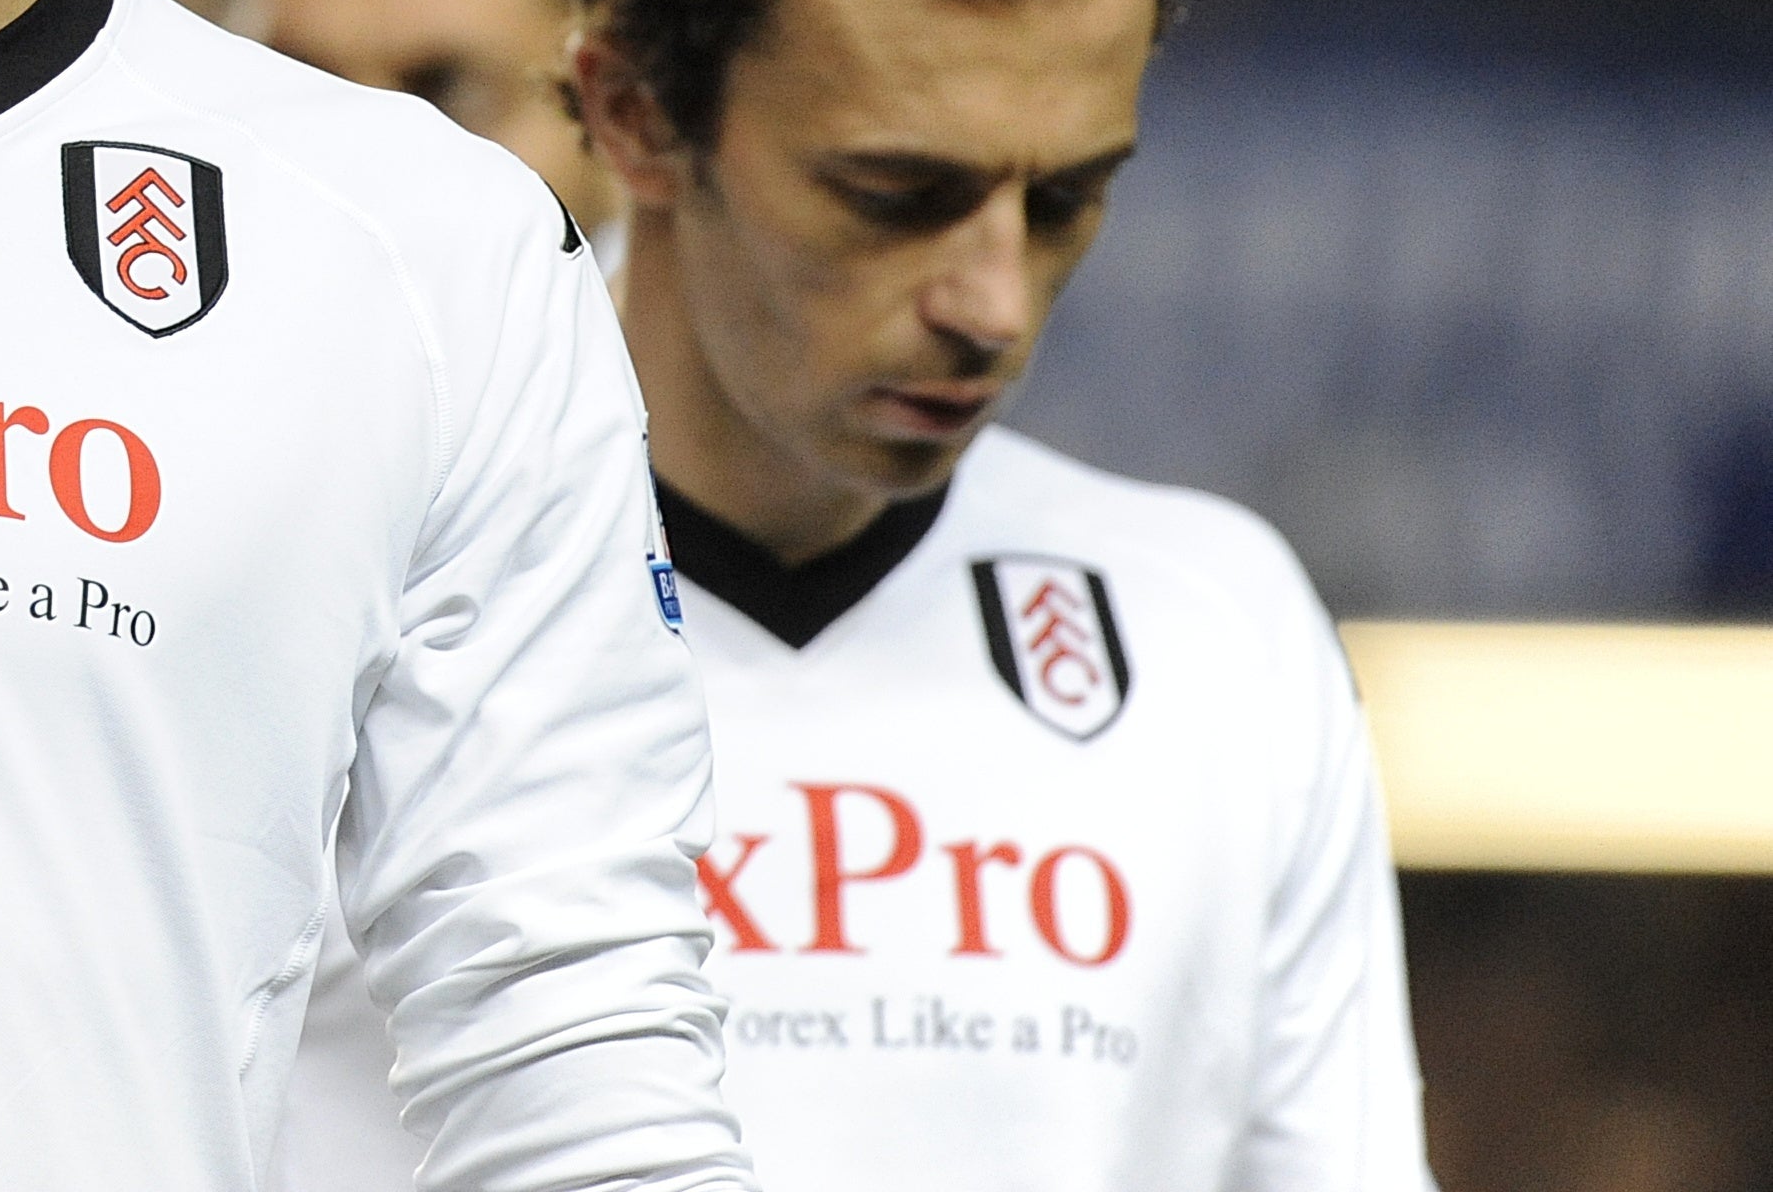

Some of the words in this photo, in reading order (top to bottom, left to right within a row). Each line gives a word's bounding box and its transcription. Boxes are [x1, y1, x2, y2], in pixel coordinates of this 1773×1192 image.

[29, 582, 58, 621] a
[74, 577, 156, 647] Pro
[694, 780, 1134, 969] xPro
[735, 1009, 850, 1049] orex
[870, 996, 994, 1052] Like
[1011, 1016, 1041, 1053] a
[1059, 1005, 1139, 1065] Pro
